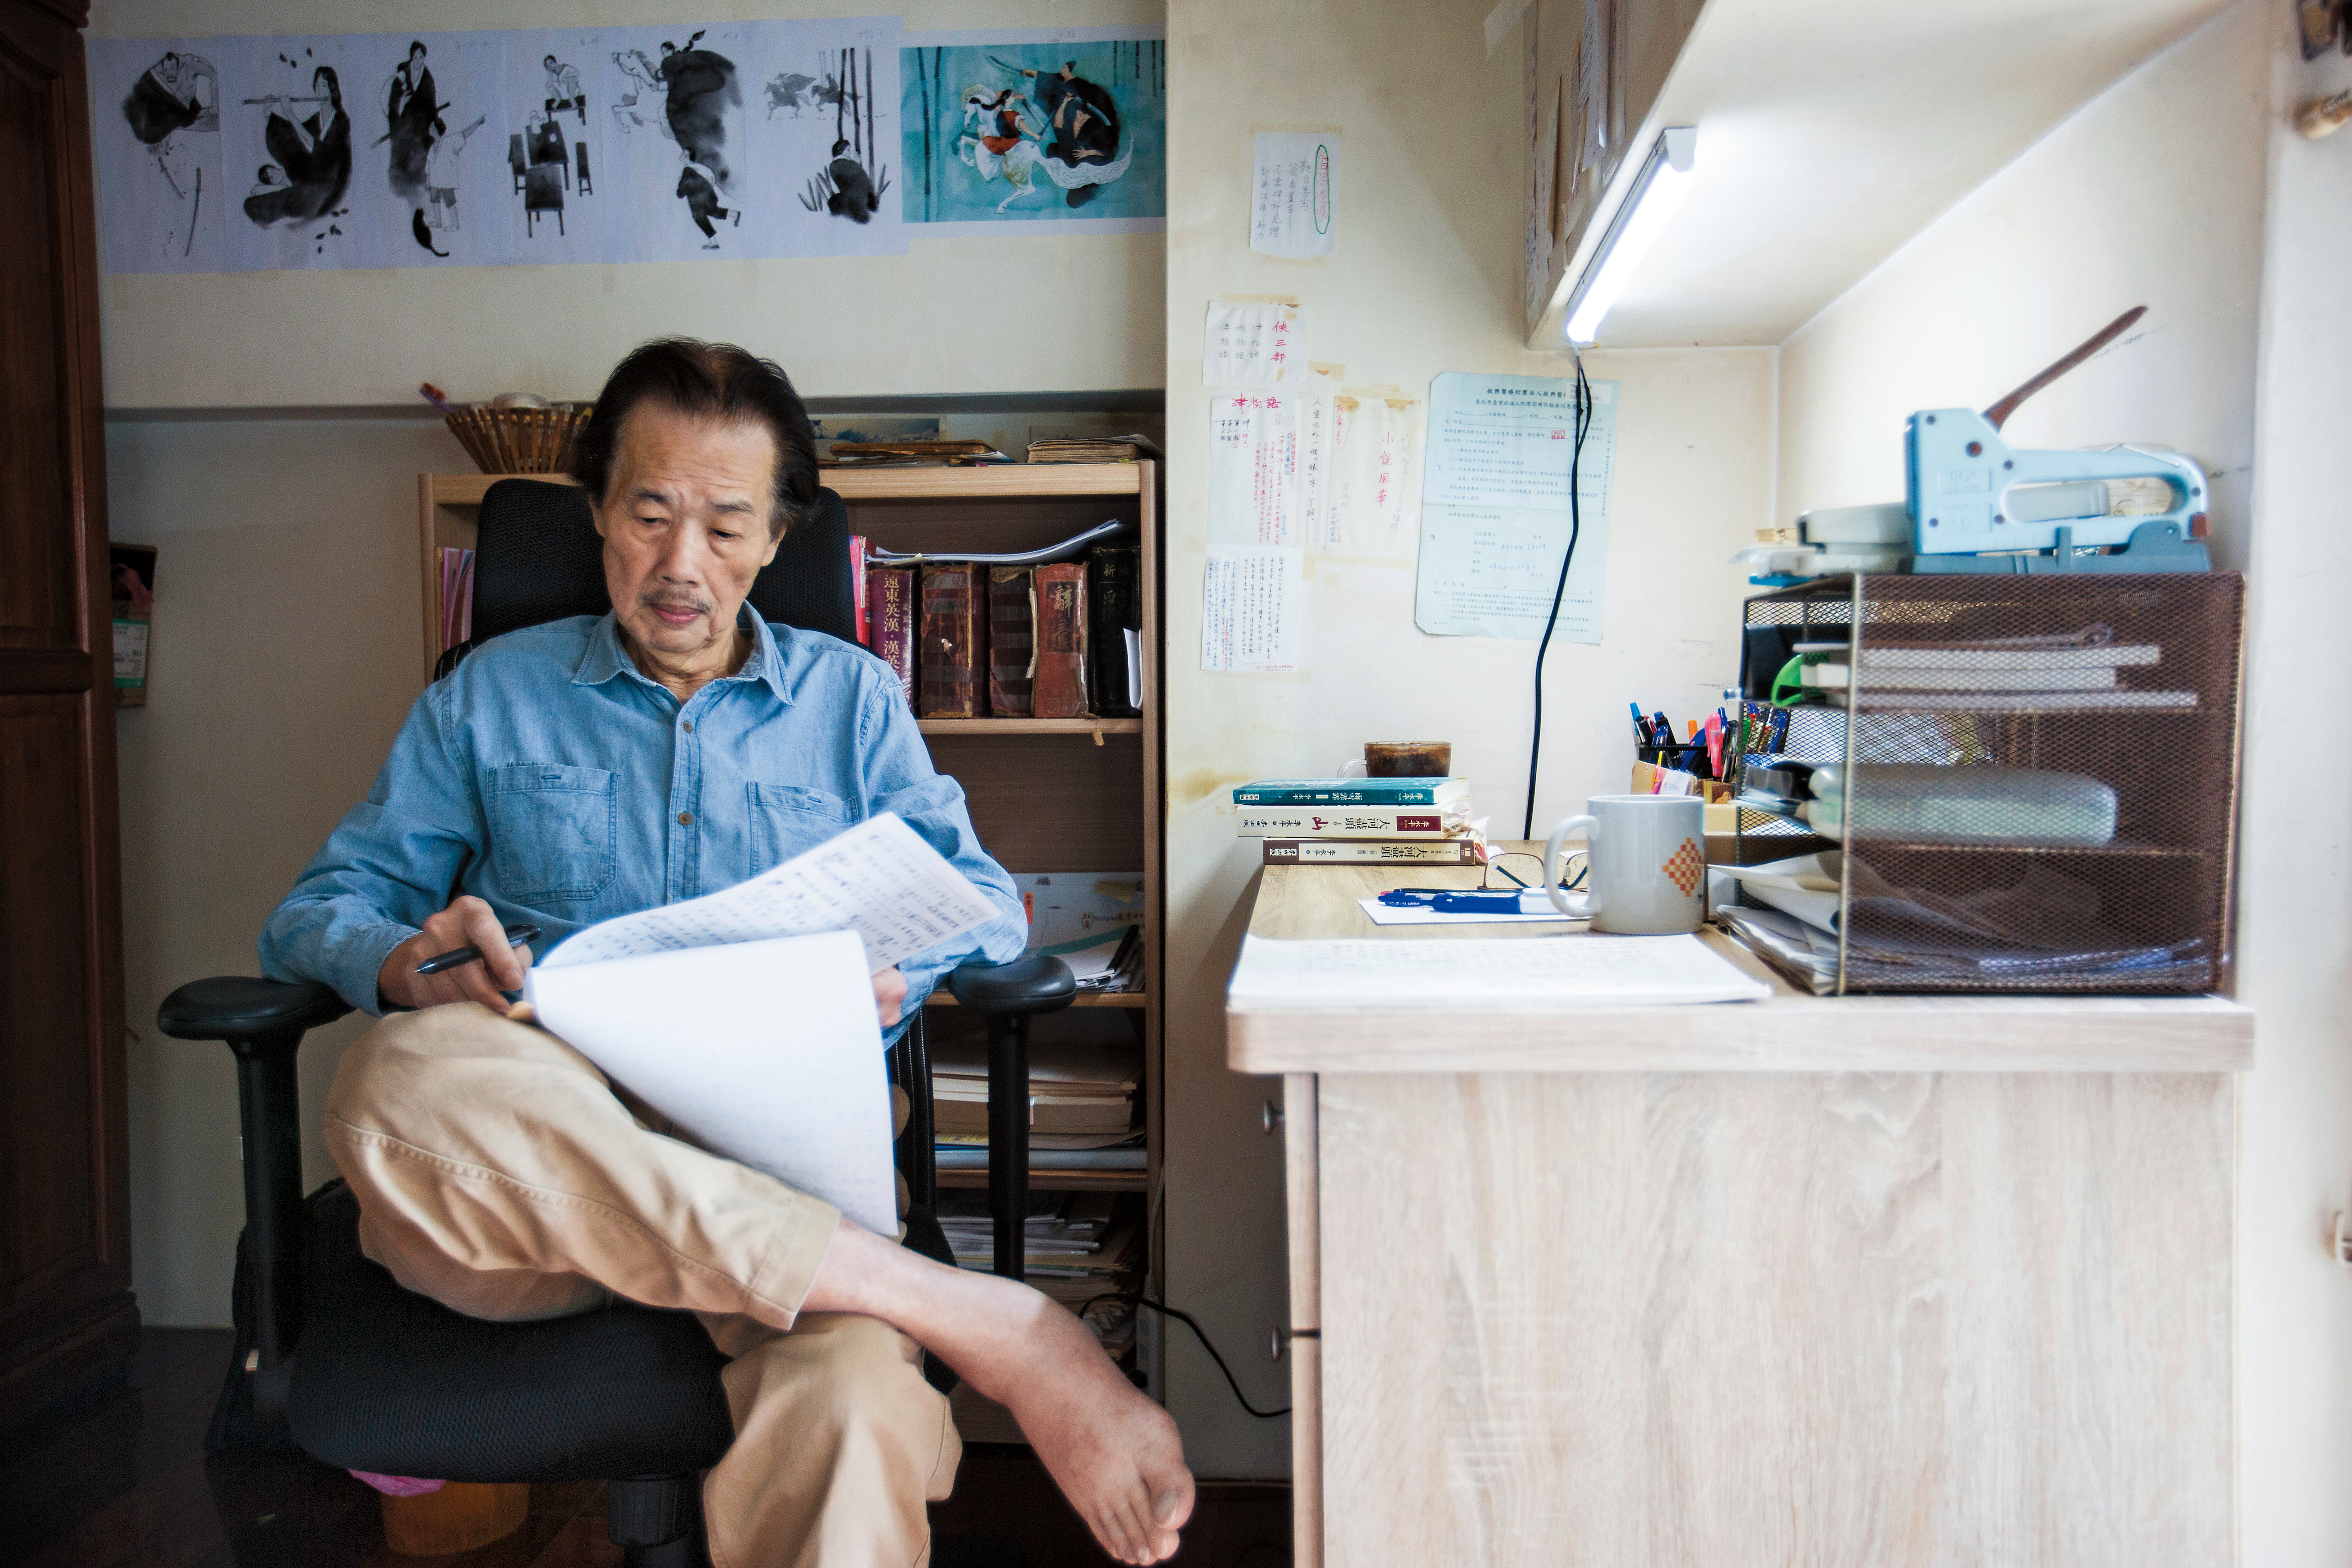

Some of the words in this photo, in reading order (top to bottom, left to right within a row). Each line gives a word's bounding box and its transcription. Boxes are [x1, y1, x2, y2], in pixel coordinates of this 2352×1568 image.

[1232, 392, 1281, 414] 津物語
[1376, 432, 1393, 508] 小說風華
[884, 574, 900, 675] 遠東英漢·漢英
[1332, 792, 1363, 800] 雨雪霏霏
[1243, 819, 1268, 827] 麥田出版
[1345, 817, 1390, 830] 大河盡頭
[1381, 846, 1428, 858] 大河盡頭
